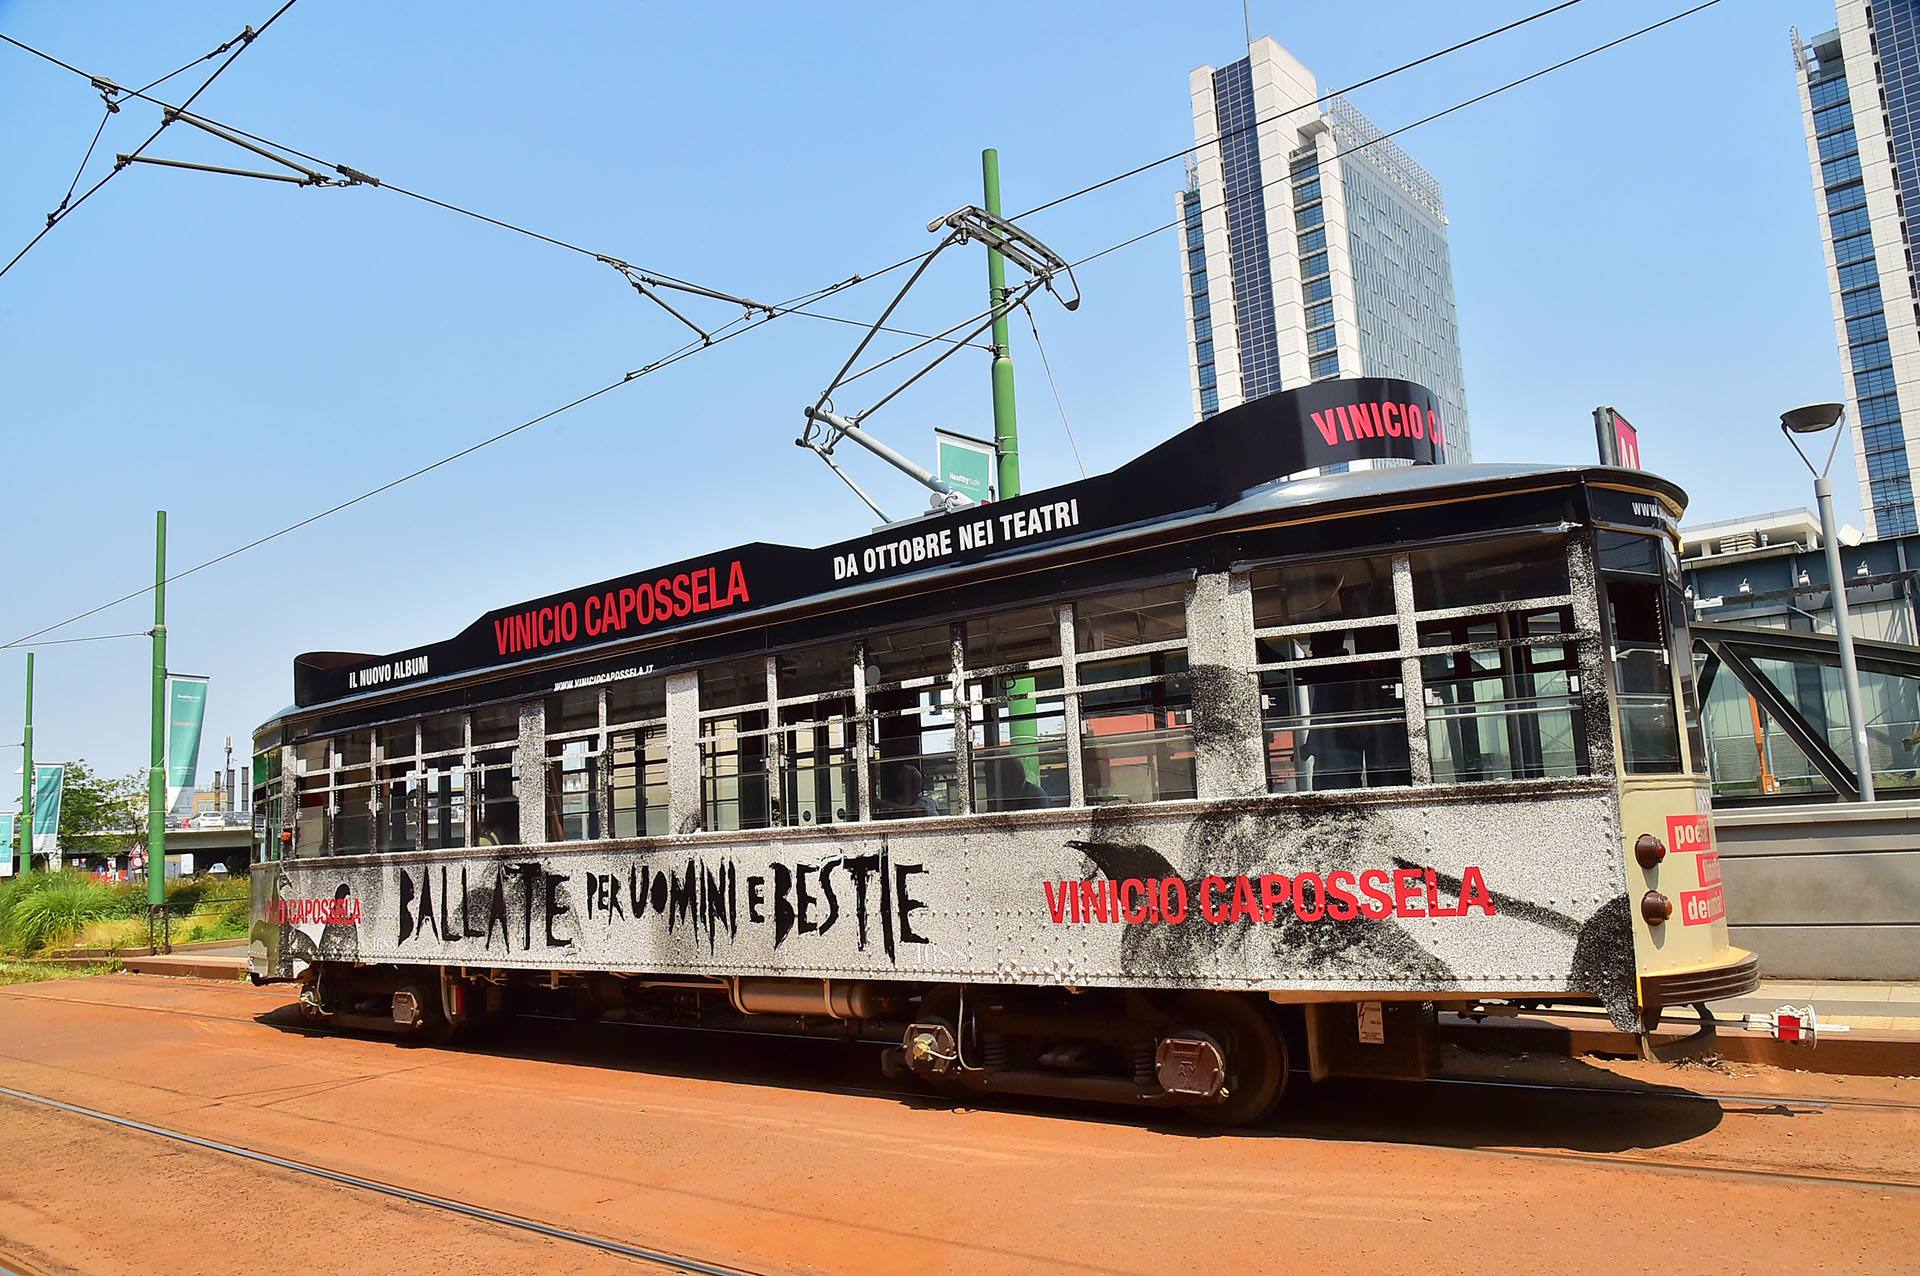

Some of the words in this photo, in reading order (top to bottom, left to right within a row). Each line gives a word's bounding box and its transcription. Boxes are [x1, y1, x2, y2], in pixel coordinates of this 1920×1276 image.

[1310, 401, 1424, 446] VINICIO
[833, 553, 859, 580] DA
[863, 530, 952, 573] OTTOBRE
[958, 519, 994, 551] NEI
[1000, 498, 1080, 541] TEATRI
[494, 601, 578, 656] VINICIO
[584, 560, 750, 637] CAPOSSELA
[349, 672, 358, 689] IL
[359, 663, 392, 687] NUOVO
[393, 655, 429, 680] ALBUM
[288, 896, 362, 926] CAPOSSELA
[397, 863, 574, 954] BALLATE
[586, 871, 625, 926] PER
[628, 856, 737, 957] UOMINI
[747, 875, 765, 923] E
[768, 848, 929, 967] BESTIE
[1043, 877, 1188, 924] VINICIO
[1200, 866, 1497, 924] CAPOSSELA
[917, 941, 968, 966] 1688
